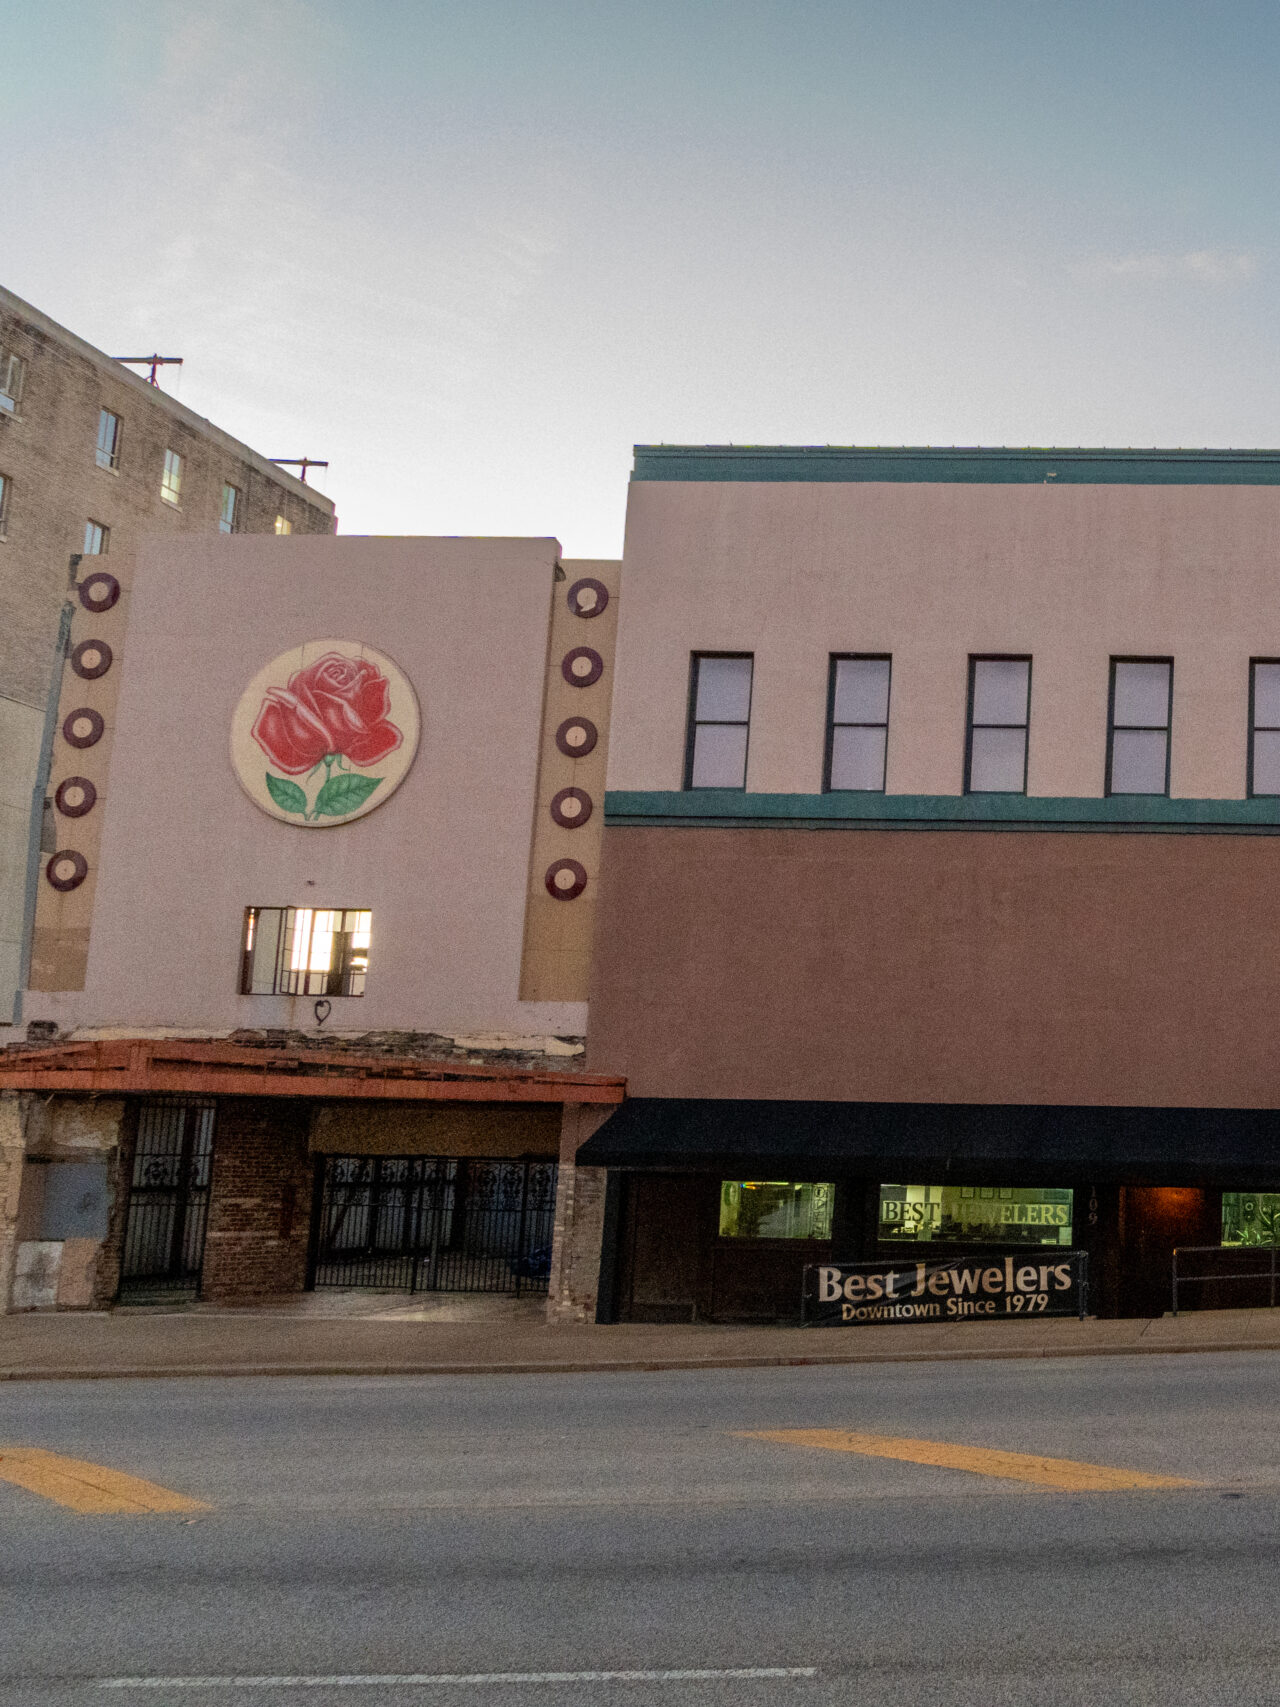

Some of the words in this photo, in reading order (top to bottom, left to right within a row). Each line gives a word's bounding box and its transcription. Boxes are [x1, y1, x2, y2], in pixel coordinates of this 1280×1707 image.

[884, 1201, 941, 1221] BEST
[818, 1265, 900, 1302] Best
[911, 1256, 1072, 1297] Jewelers
[841, 1301, 941, 1321] Downtown
[946, 1297, 996, 1315] Since
[1004, 1293, 1049, 1313] 1979
